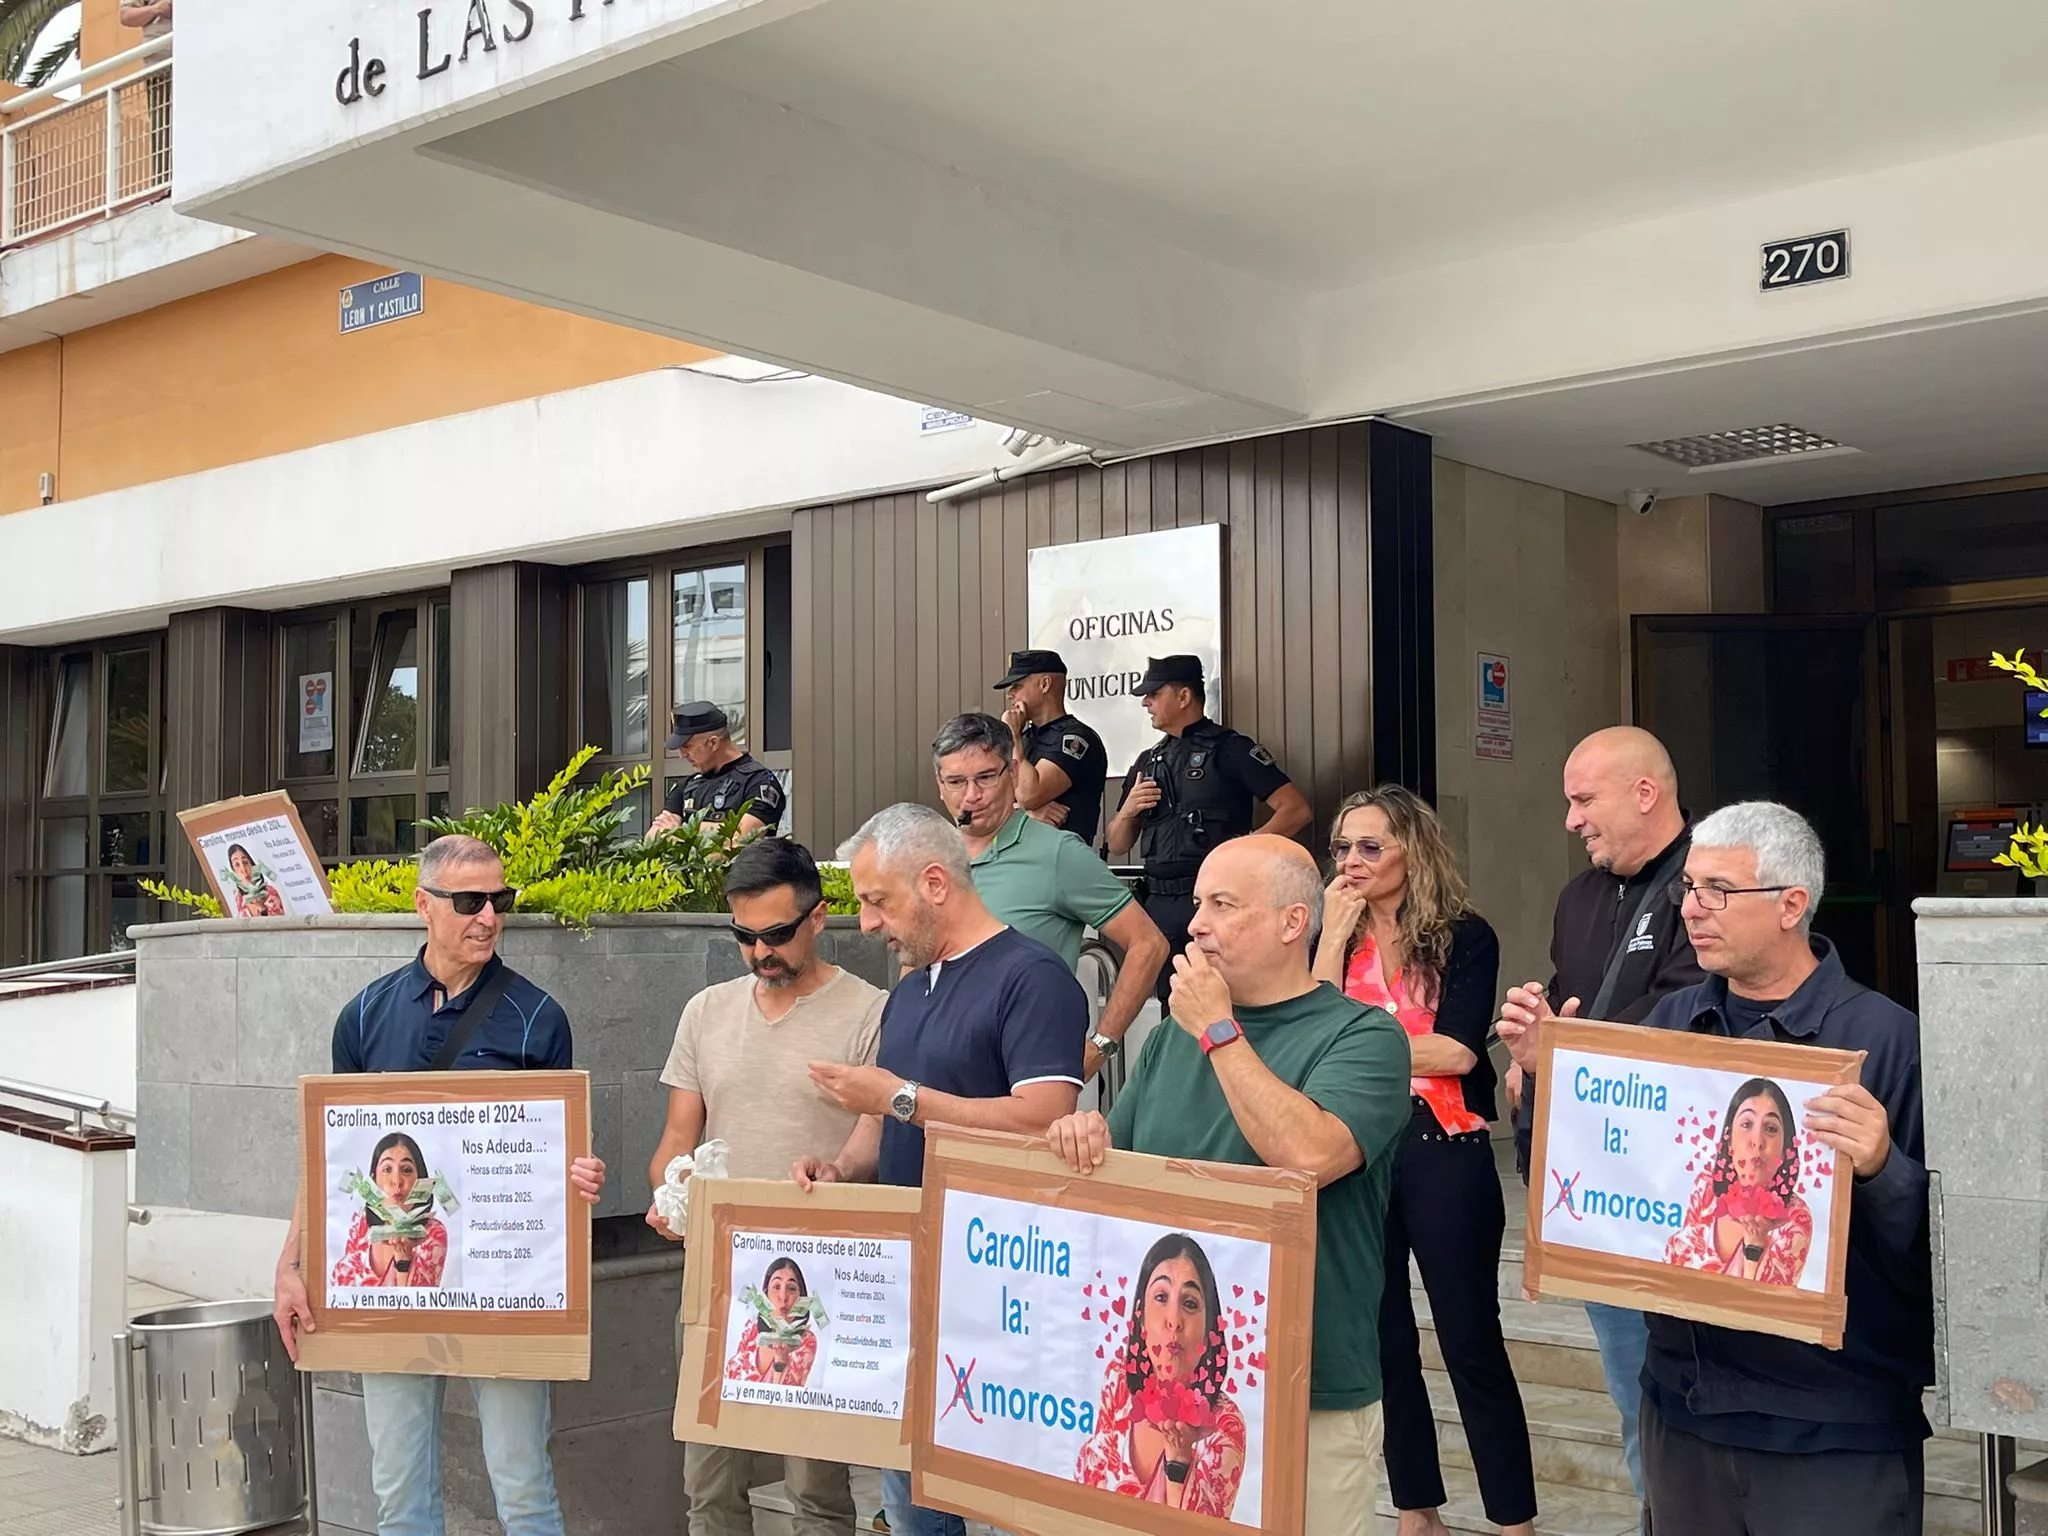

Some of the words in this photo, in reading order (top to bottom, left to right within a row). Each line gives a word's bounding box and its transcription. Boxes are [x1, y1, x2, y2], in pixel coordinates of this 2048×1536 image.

[335, 38, 386, 105] de
[416, 0, 535, 80] LAS
[1769, 240, 1839, 284] 270
[373, 277, 400, 293] CALLE
[344, 307, 365, 328] LEON
[369, 304, 375, 322] Y
[378, 293, 418, 319] CASTILLO
[1069, 608, 1174, 641] OFICINAS
[1066, 671, 1143, 700] UNICIP
[1574, 1066, 1667, 1112] Carolina
[327, 1108, 381, 1130] Carolina,
[385, 1110, 434, 1126] morosa
[438, 1105, 475, 1124] desde
[479, 1105, 490, 1123] el
[462, 1139, 483, 1154] Nos
[1604, 1117, 1628, 1155] la:
[470, 1164, 490, 1175] Horas
[491, 1164, 513, 1175] extras
[471, 1192, 490, 1203] Horas
[492, 1192, 513, 1203] extras
[491, 1248, 513, 1259] extras
[733, 1233, 775, 1253] Carolina,
[777, 1239, 813, 1253] morosa
[816, 1239, 846, 1256] desde
[847, 1241, 856, 1256] el
[967, 1217, 1070, 1277] Carolina
[834, 1268, 851, 1281] Nos
[352, 1294, 358, 1309] y
[361, 1294, 375, 1306] en
[378, 1294, 414, 1310] mayo,
[416, 1292, 426, 1307] la
[429, 1288, 478, 1308] NÓMINA
[480, 1296, 494, 1310] pa
[1002, 1285, 1029, 1335] la:
[736, 1386, 741, 1400] y
[743, 1387, 755, 1398] en
[785, 1389, 793, 1402] la
[795, 1387, 833, 1407] NÓMINA
[835, 1397, 846, 1411] pa
